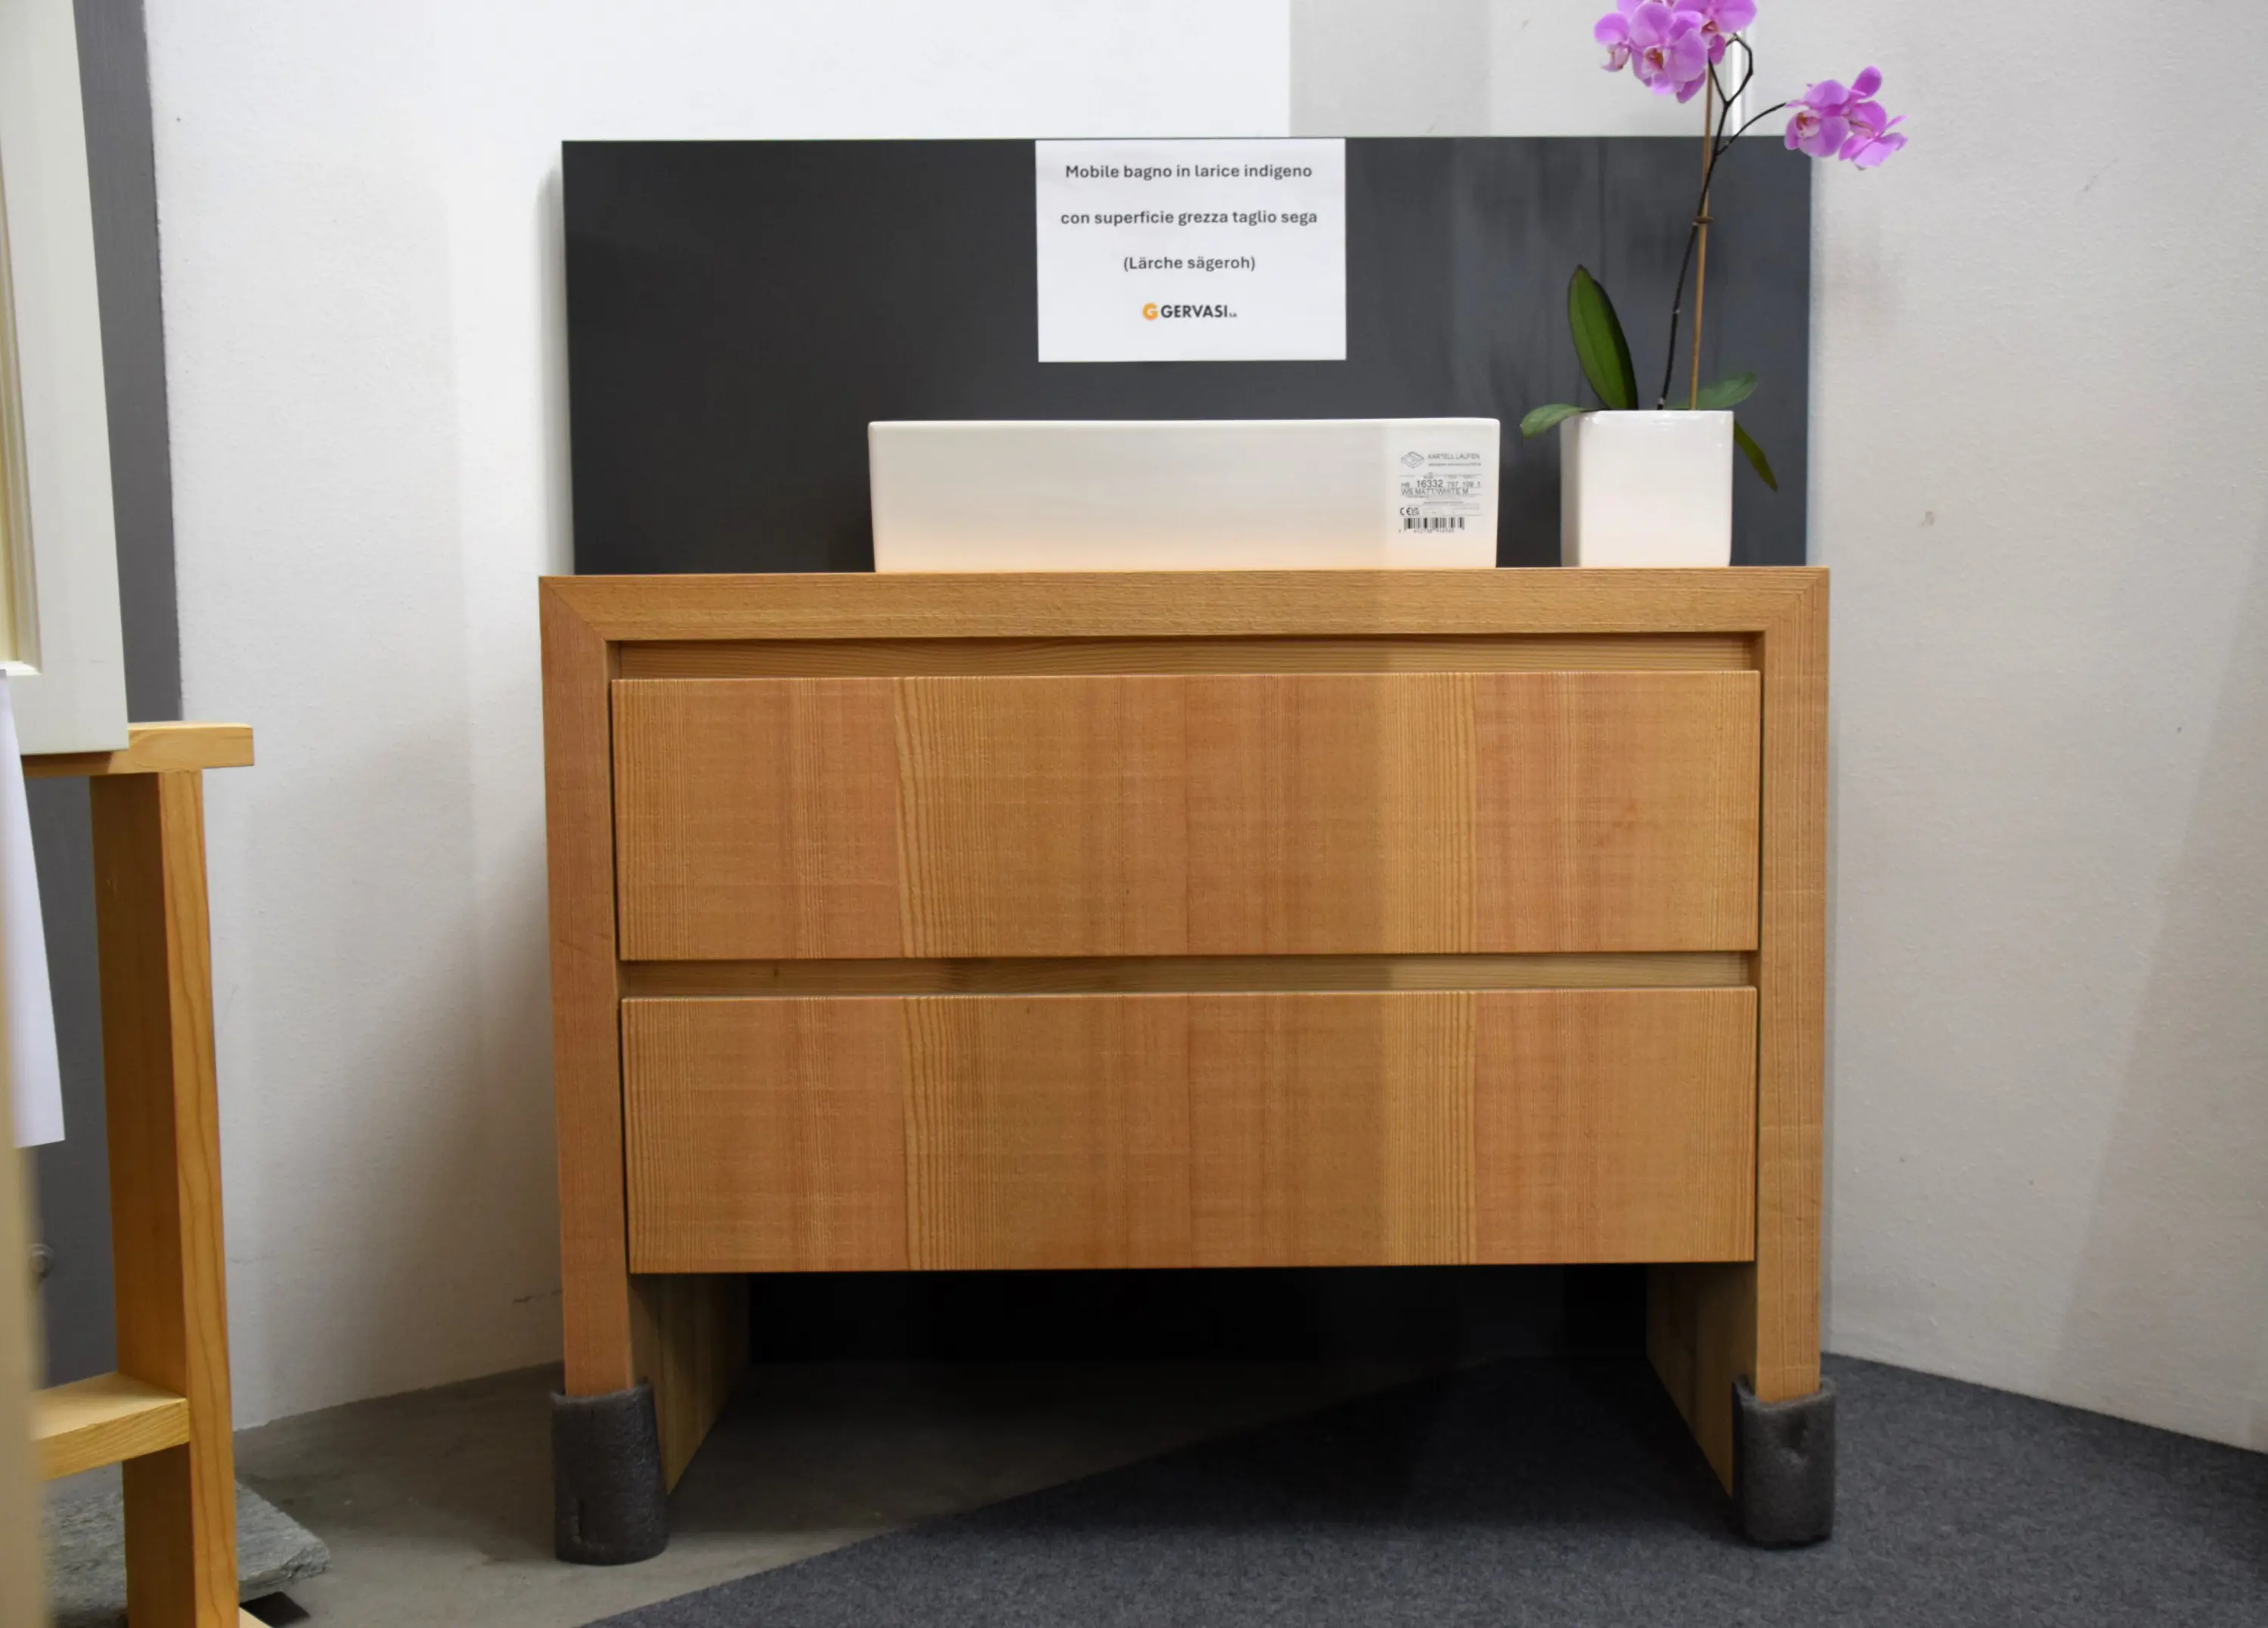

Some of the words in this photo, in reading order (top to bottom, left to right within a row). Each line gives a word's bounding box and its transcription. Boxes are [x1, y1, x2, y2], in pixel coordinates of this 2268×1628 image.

[1066, 164, 1120, 178] Mobile
[1123, 164, 1173, 181] bagno
[1176, 164, 1191, 178] in
[1194, 164, 1240, 178] larice
[1244, 163, 1312, 181] indigeno
[1060, 214, 1090, 225] con
[1094, 211, 1175, 228] superficie
[1178, 212, 1228, 227] grezza
[1232, 210, 1278, 227] taglio
[1281, 212, 1318, 227] sega
[1123, 256, 1183, 273] (Lärche
[1187, 256, 1256, 272] sägeroh)
[1160, 304, 1228, 318] GERVASI
[1416, 479, 1443, 488] 16332
